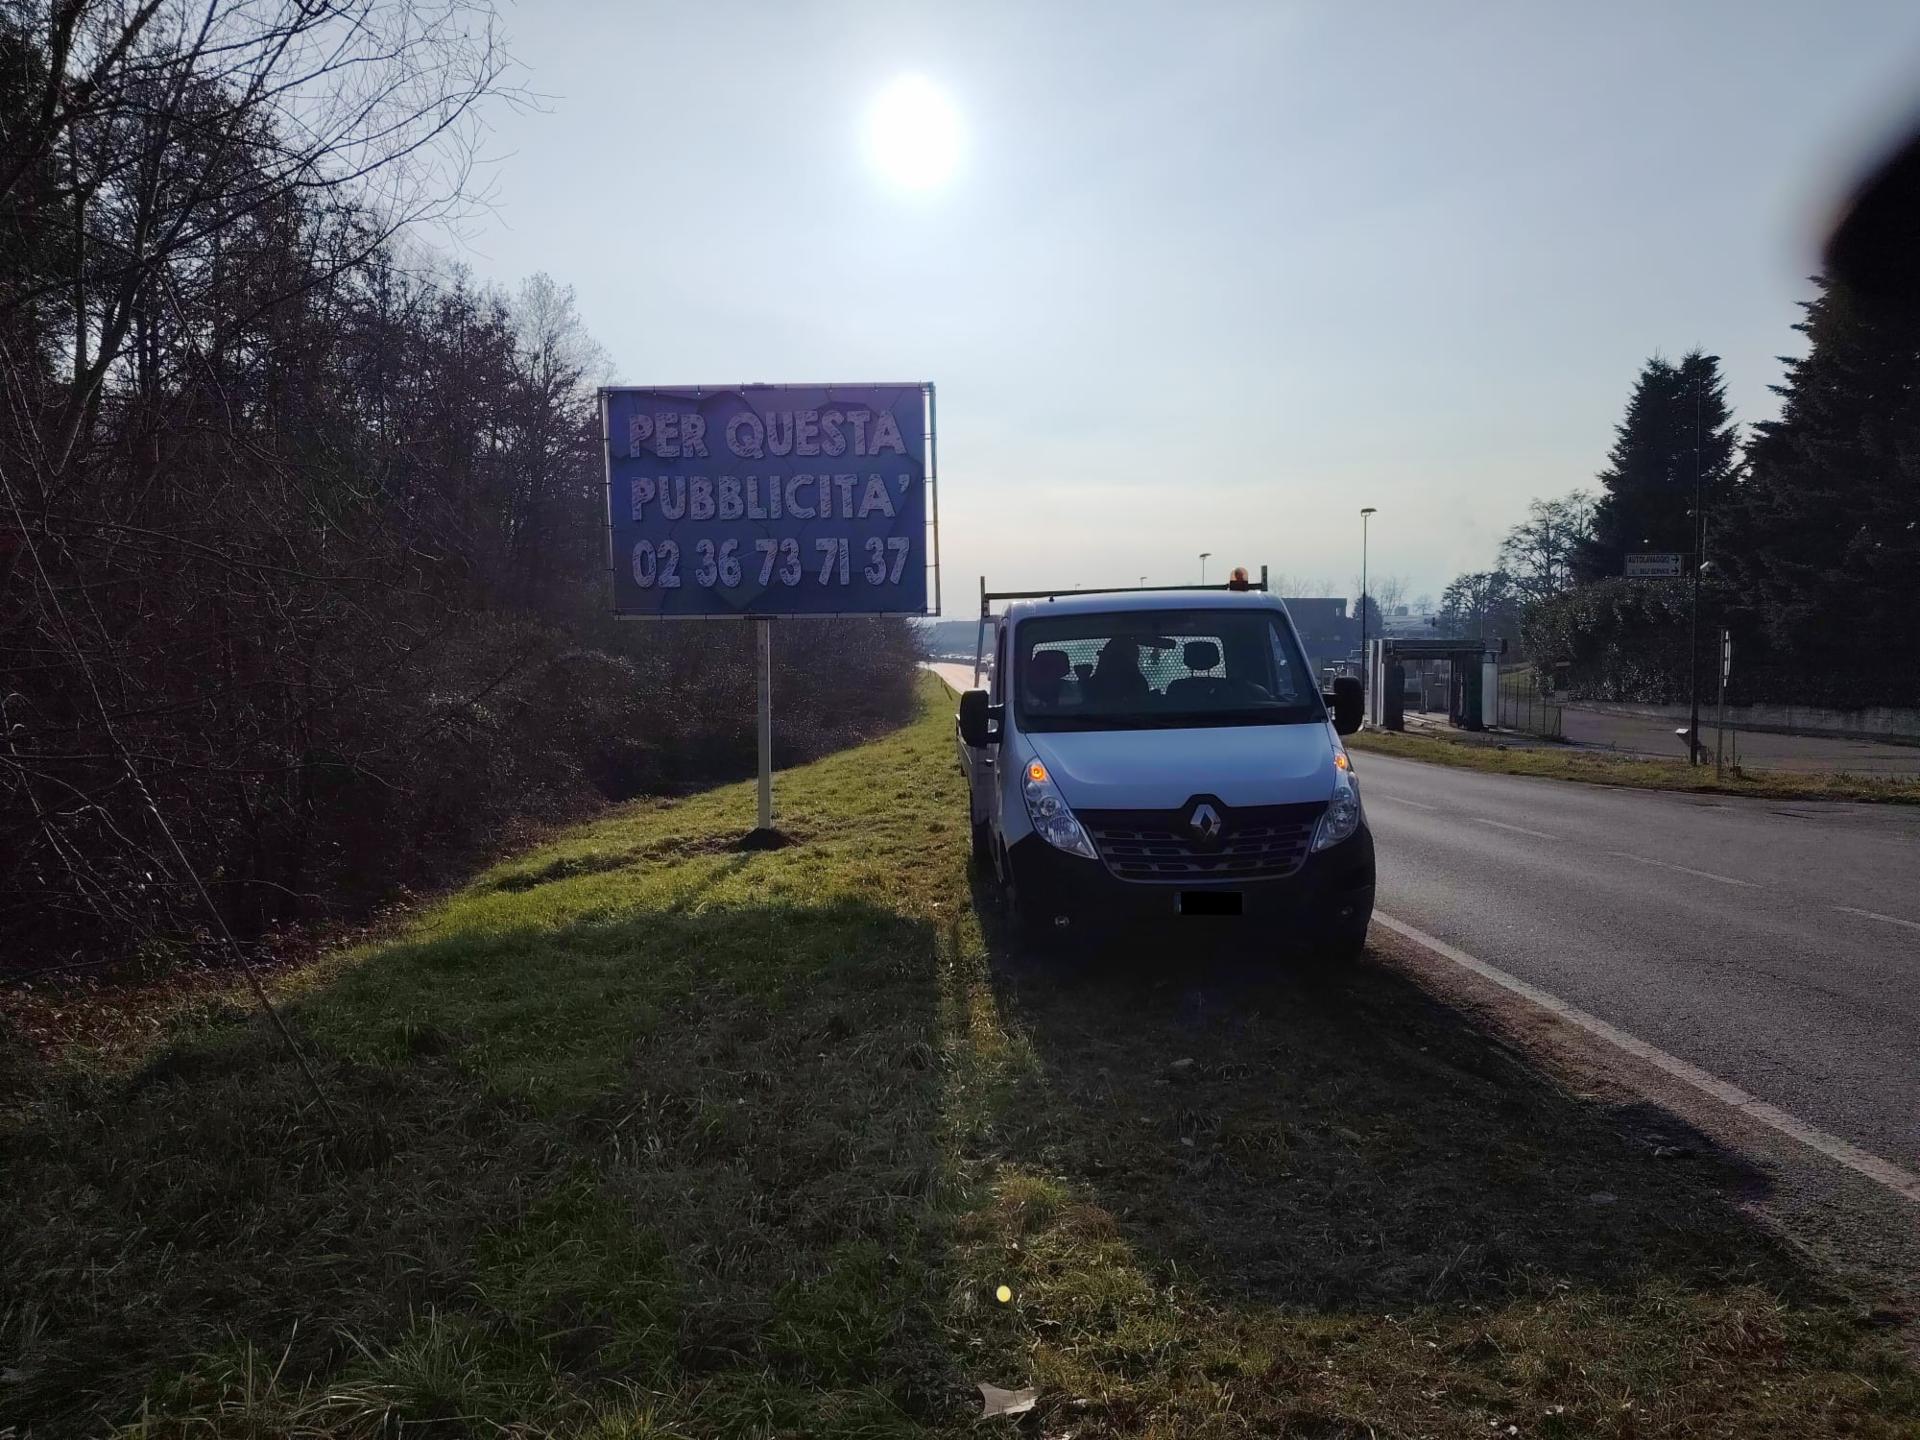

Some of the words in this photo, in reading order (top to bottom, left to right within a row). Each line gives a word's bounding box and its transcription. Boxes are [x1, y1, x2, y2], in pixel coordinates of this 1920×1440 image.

[629, 412, 709, 458] PER
[725, 410, 907, 459] QUESTA
[631, 473, 910, 521] PUBBLICITA'
[632, 539, 681, 588] 02
[695, 538, 742, 588] 36
[755, 538, 801, 586] 73
[815, 537, 850, 585] 71
[864, 536, 910, 586] 37
